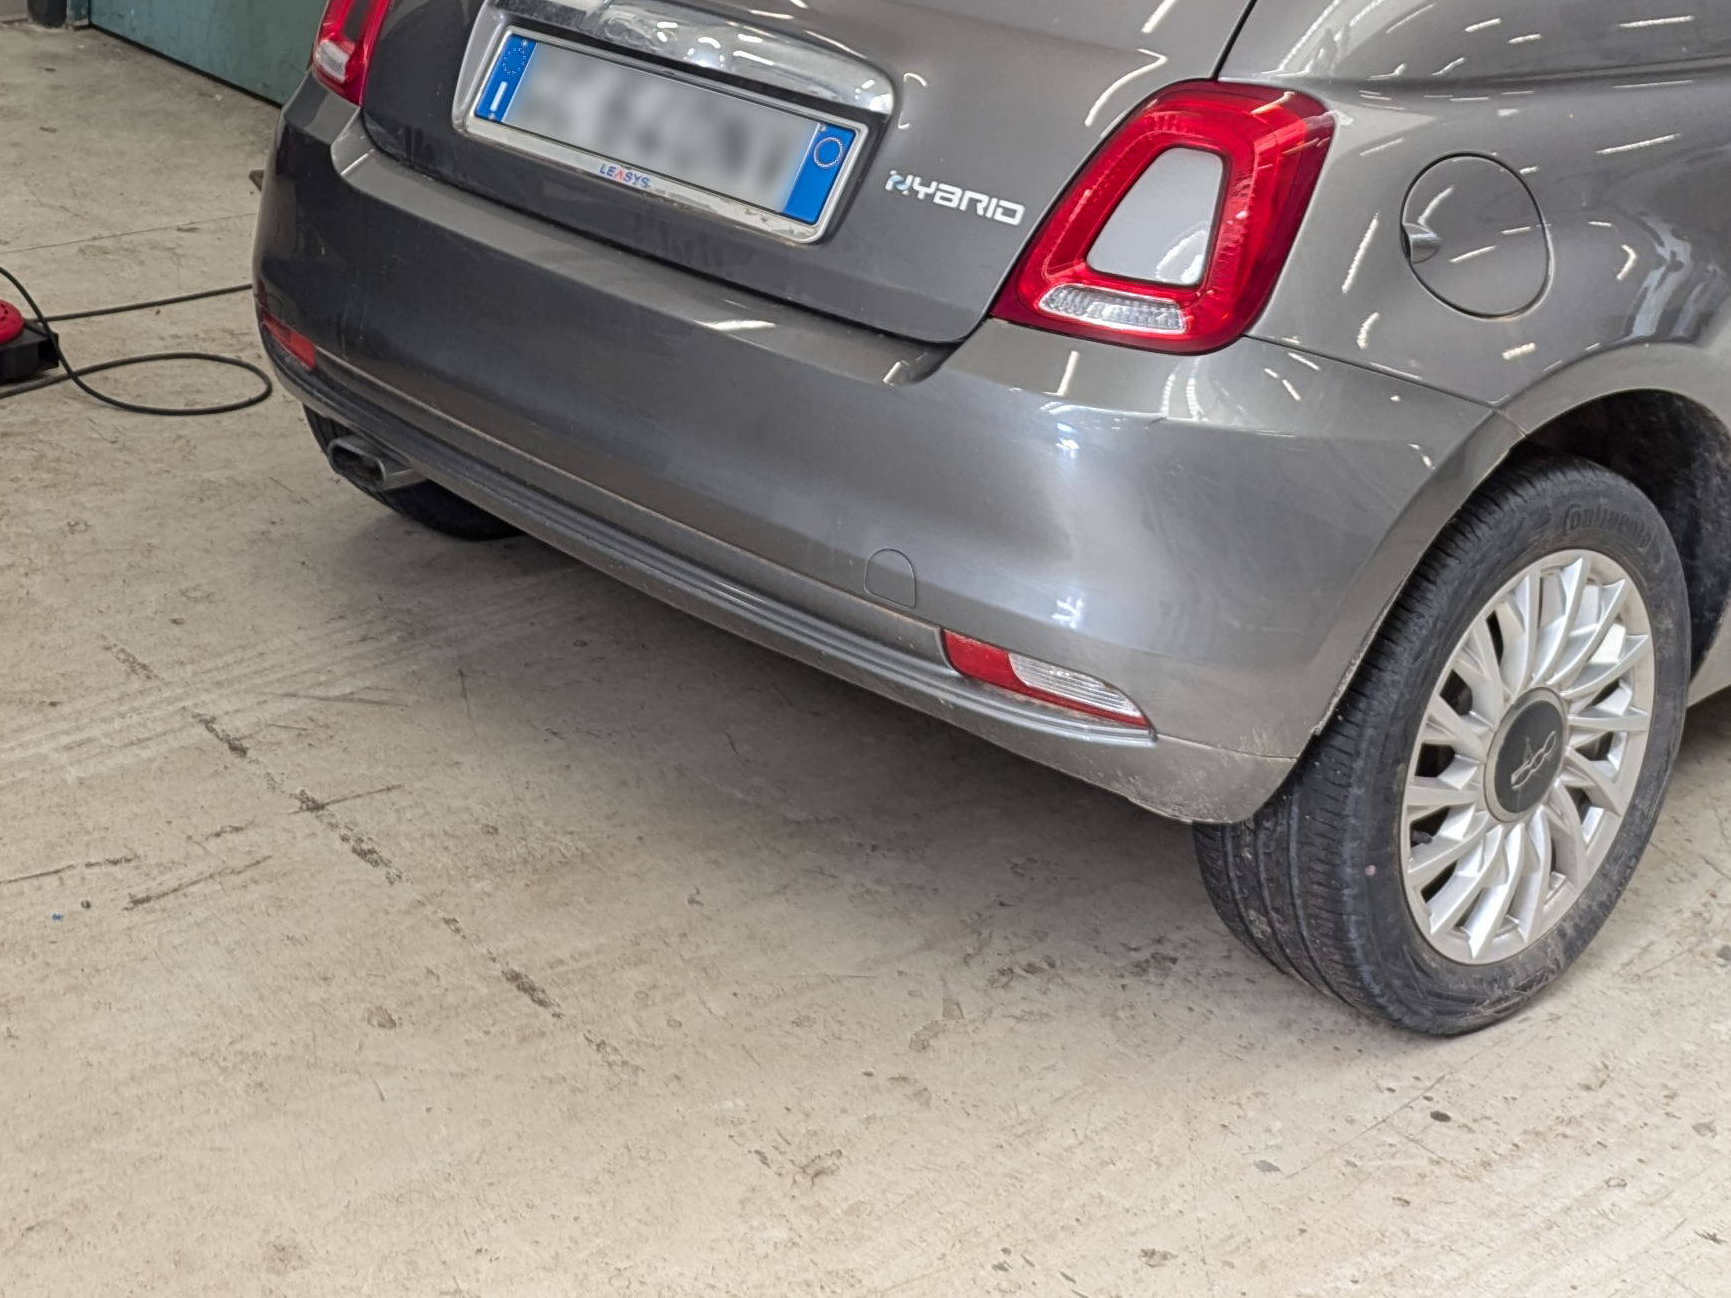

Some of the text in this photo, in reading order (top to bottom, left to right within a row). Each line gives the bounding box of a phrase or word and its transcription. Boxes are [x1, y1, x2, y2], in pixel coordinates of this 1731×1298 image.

[490, 81, 507, 112] I
[599, 163, 650, 188] LEASYS
[884, 170, 1025, 226] HYBRID
